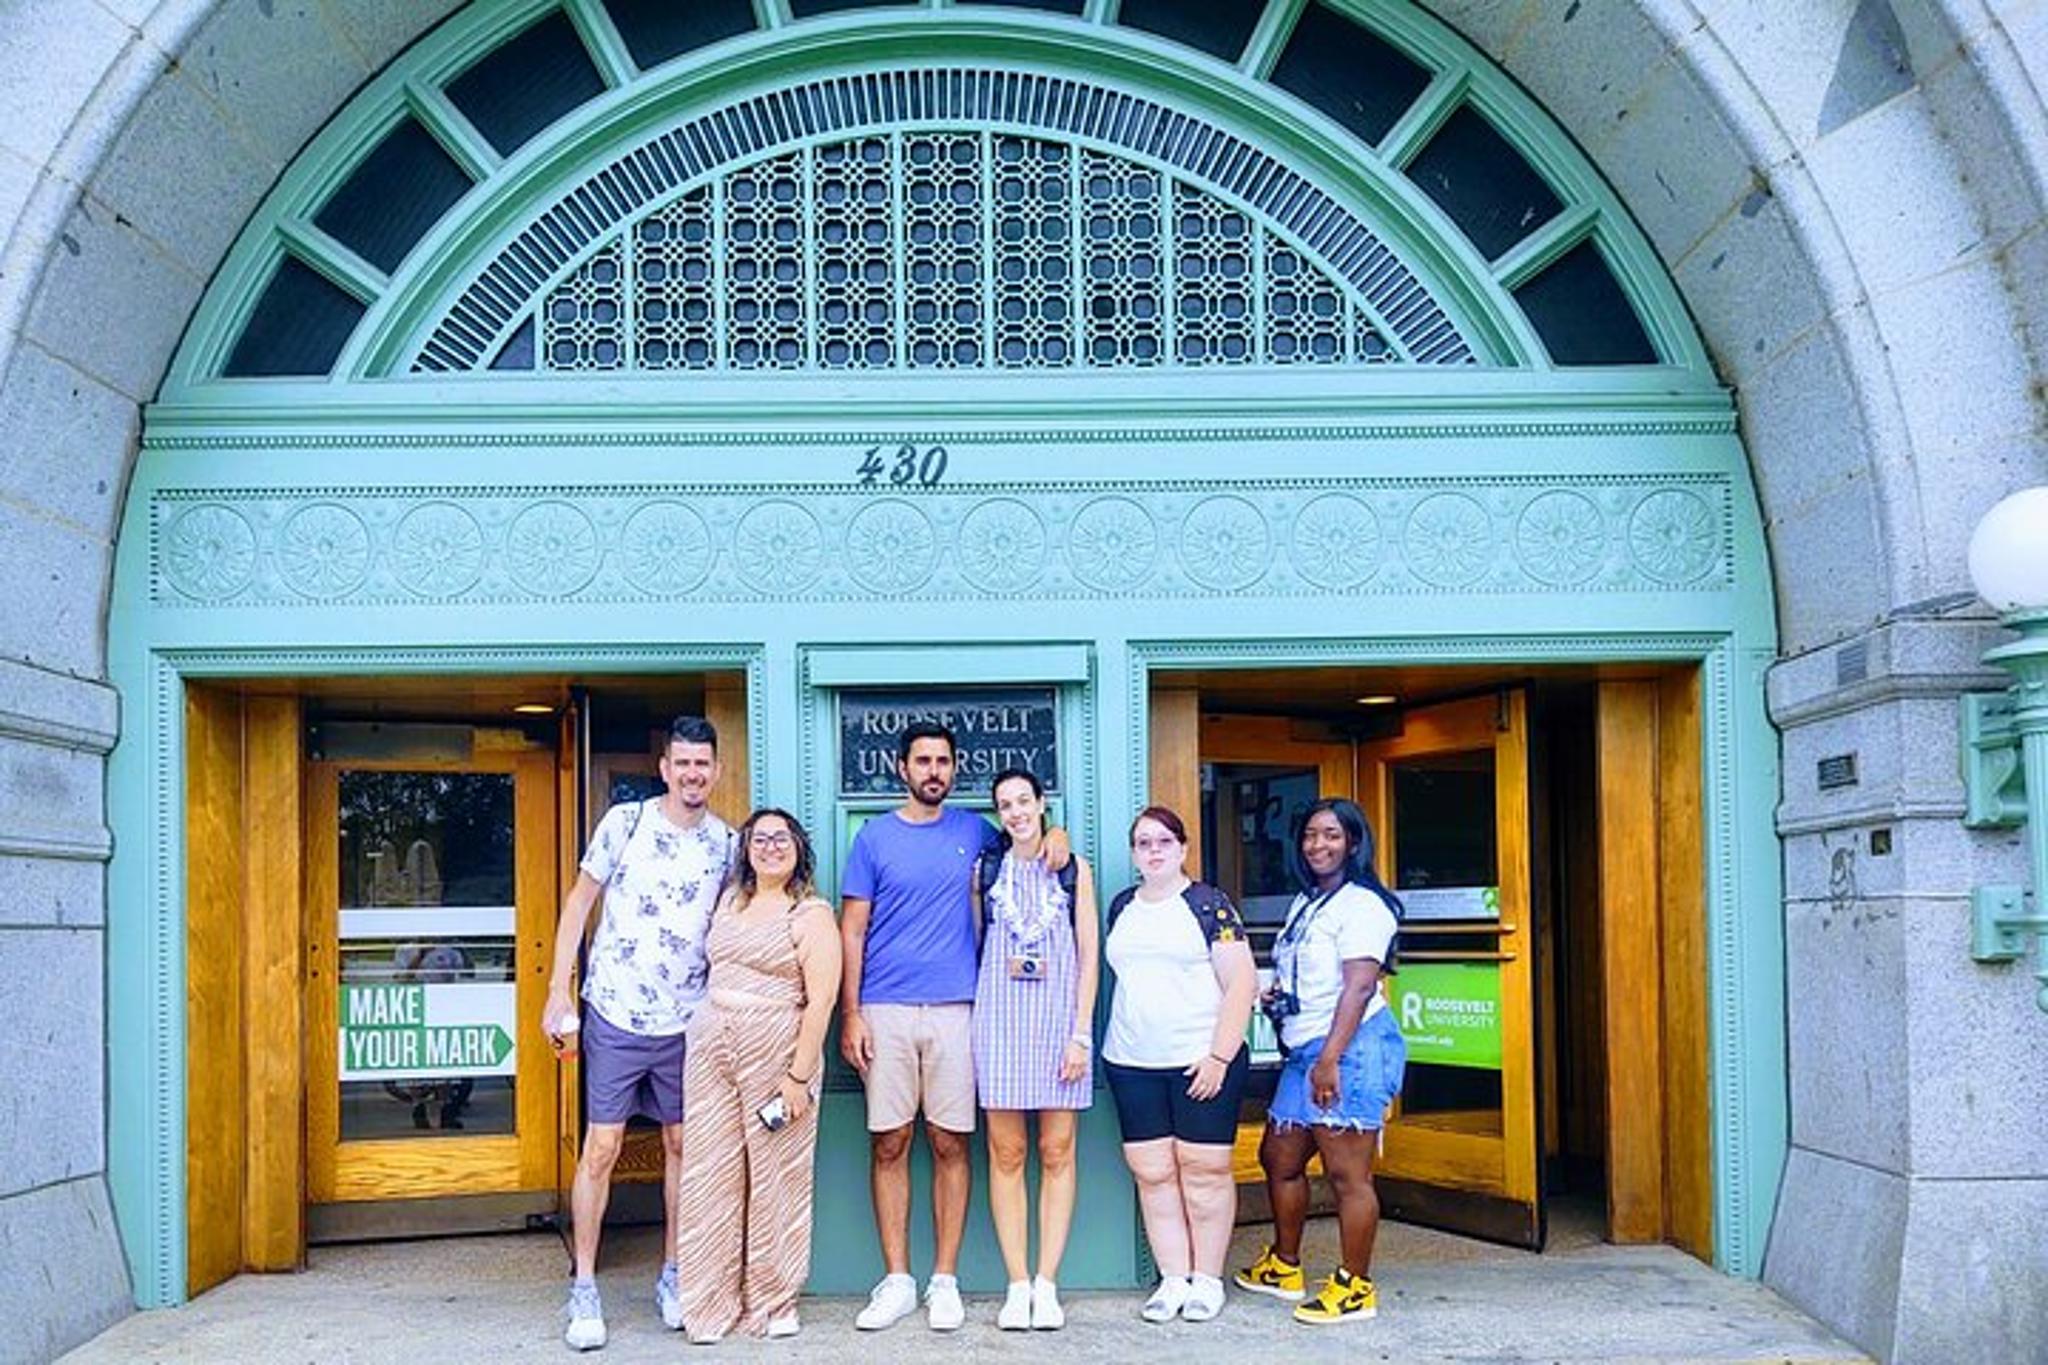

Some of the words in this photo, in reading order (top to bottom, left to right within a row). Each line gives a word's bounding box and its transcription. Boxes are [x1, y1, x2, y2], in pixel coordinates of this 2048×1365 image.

[856, 444, 948, 487] 430
[858, 749, 1038, 774] UNRSITY
[350, 986, 420, 1024] MAKE
[1402, 992, 1424, 1030] R
[1425, 998, 1494, 1013] ROOSEVELT
[350, 1031, 418, 1067] YOUR
[426, 1029, 497, 1065] MARK
